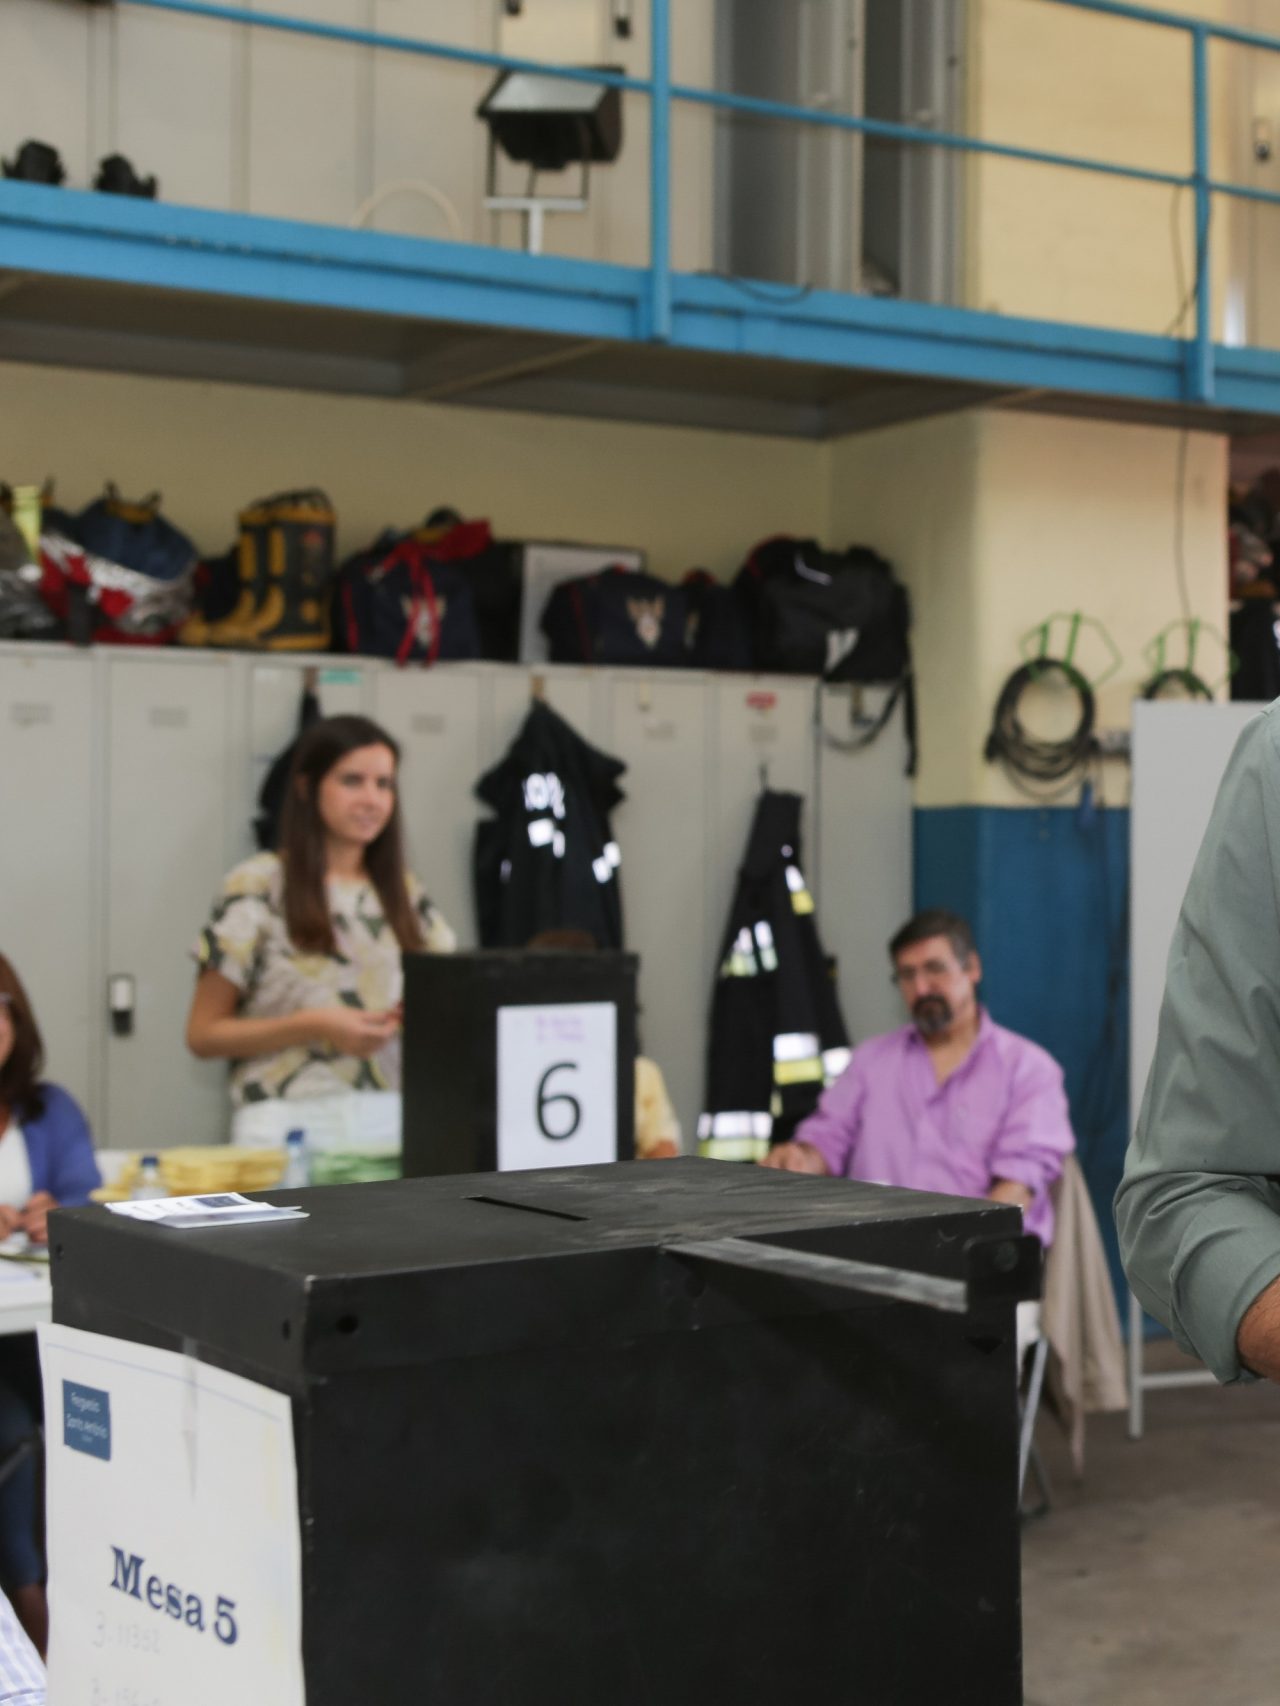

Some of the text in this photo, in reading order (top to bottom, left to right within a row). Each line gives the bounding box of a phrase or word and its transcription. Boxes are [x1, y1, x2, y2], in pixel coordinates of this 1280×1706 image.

[536, 1061, 582, 1141] 6
[110, 1545, 206, 1632] Mesa
[214, 1595, 238, 1646] 5
